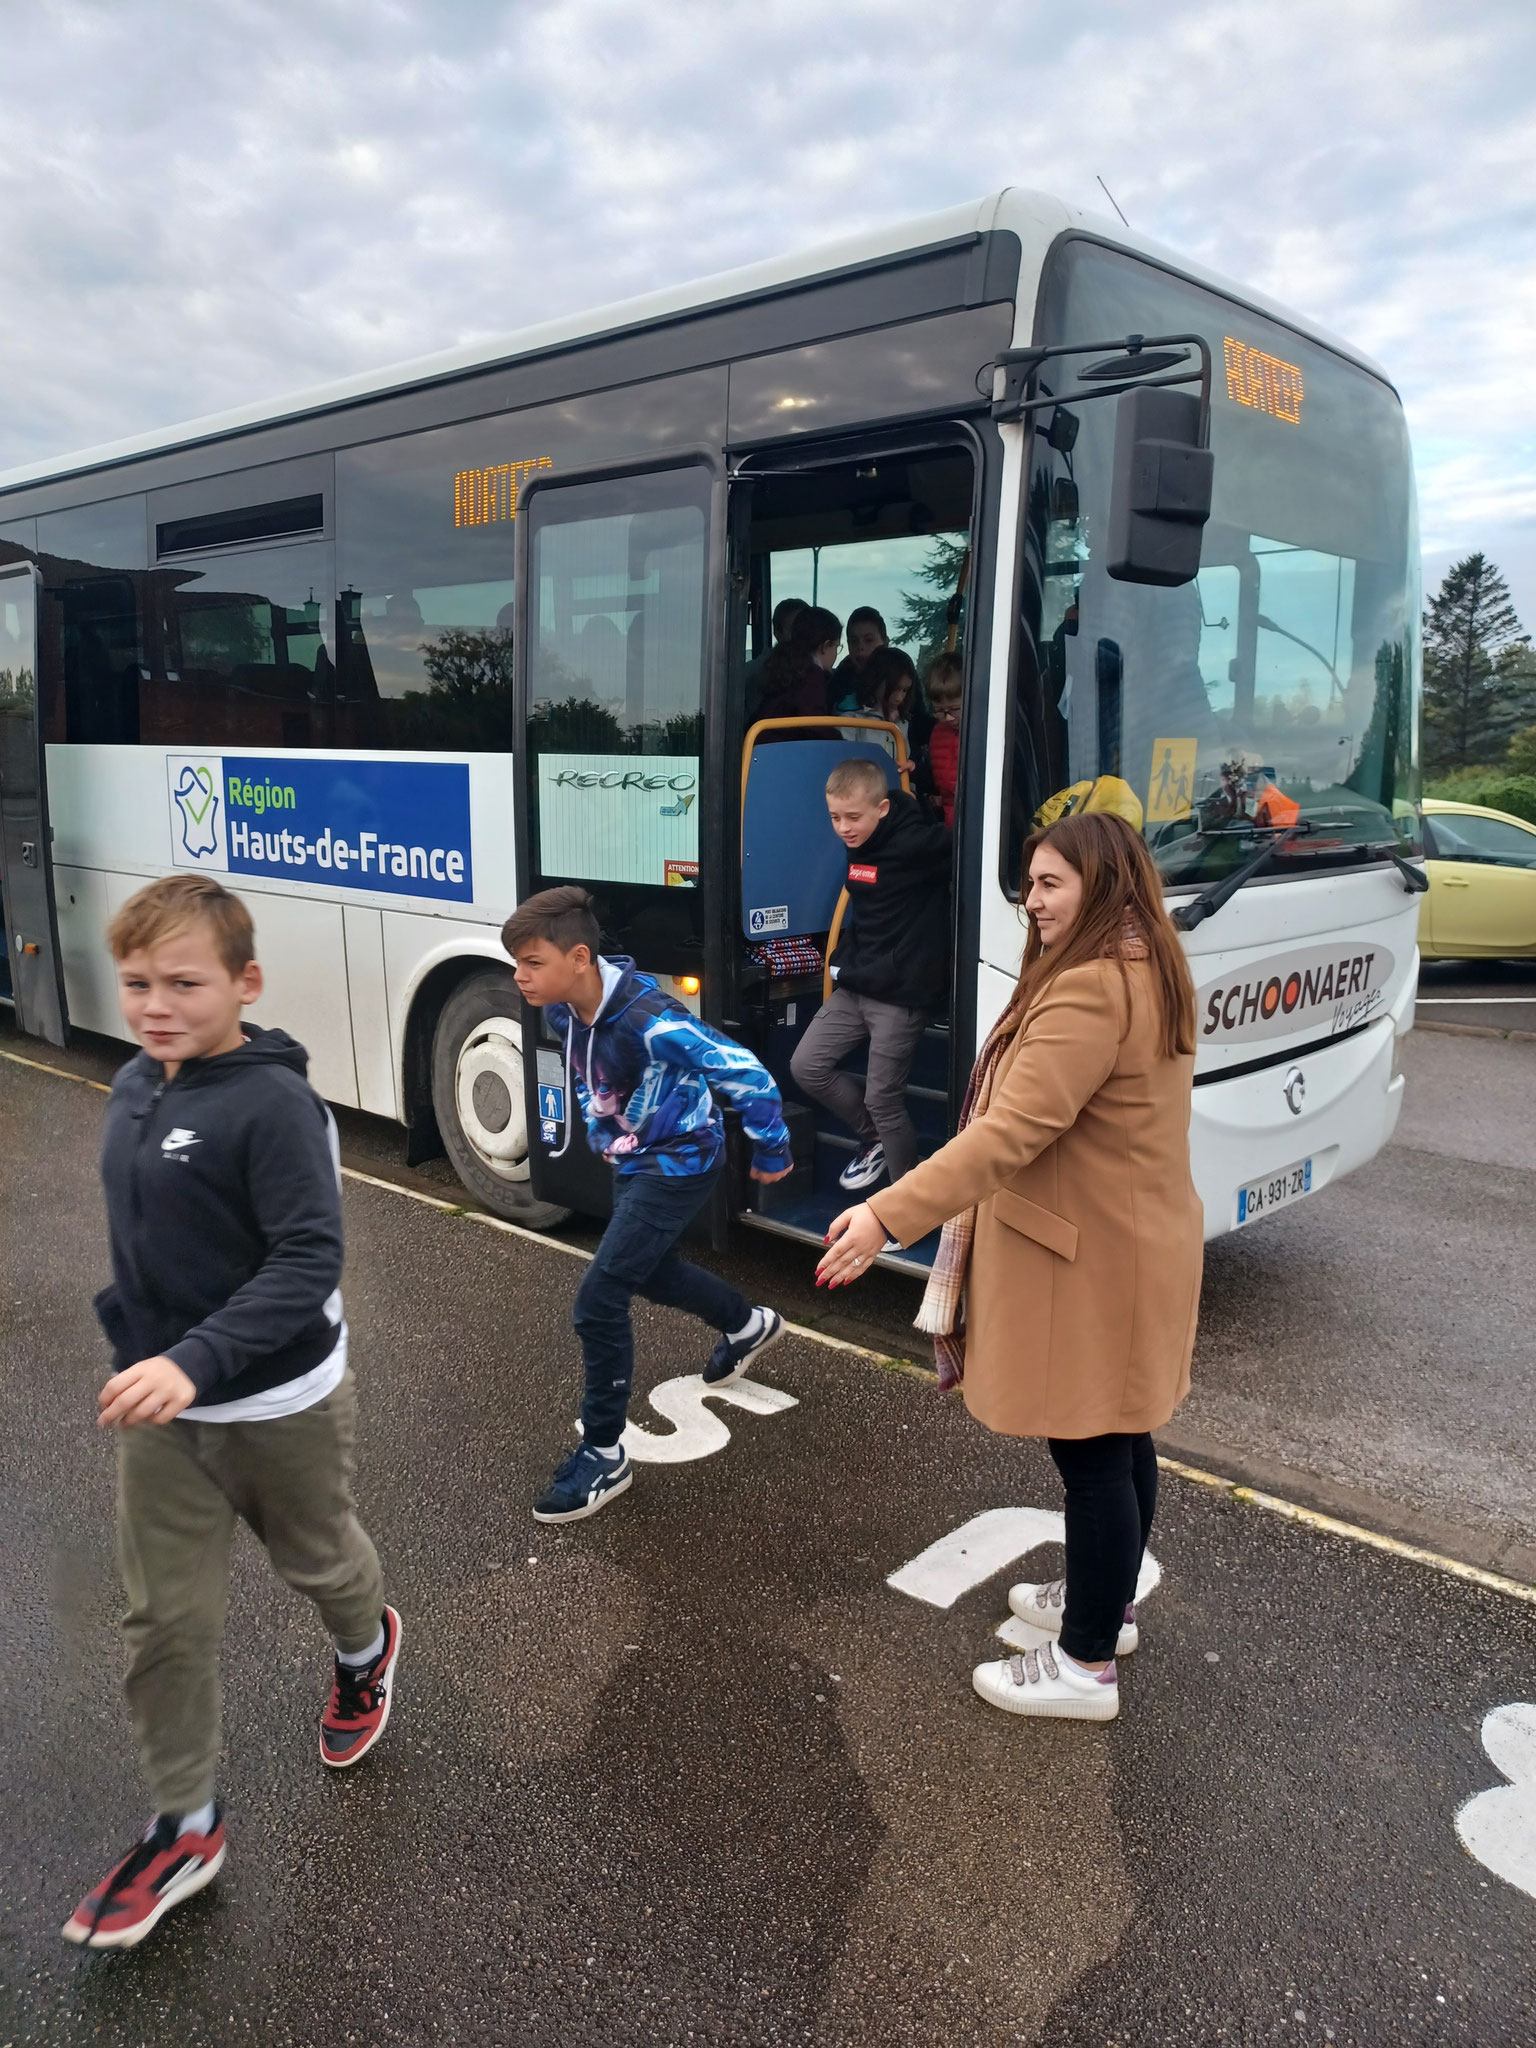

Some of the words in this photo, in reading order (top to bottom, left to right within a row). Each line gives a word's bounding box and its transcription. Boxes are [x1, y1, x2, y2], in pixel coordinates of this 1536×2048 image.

[228, 777, 297, 815] Région
[548, 768, 696, 793] RECREO
[230, 820, 465, 884] Hauts-de-France
[1203, 953, 1376, 1036] SCHOONAERT
[1331, 988, 1382, 1035] Voyages
[1246, 1168, 1304, 1214] CA-931-ZR
